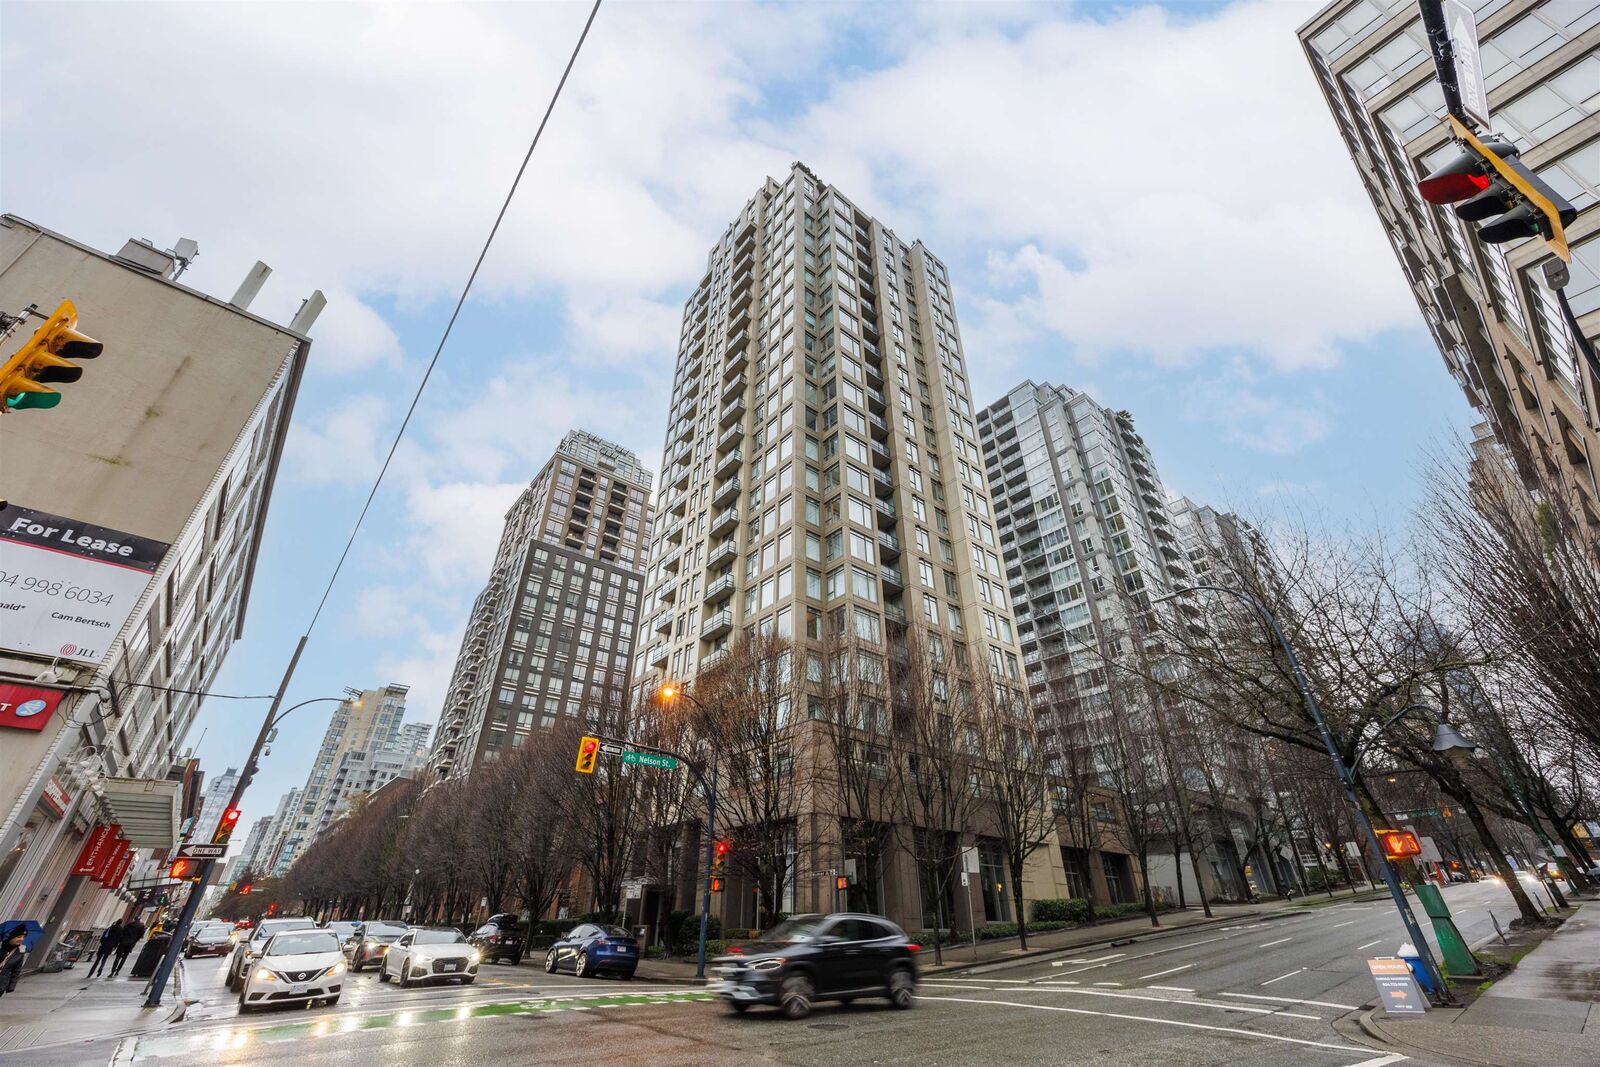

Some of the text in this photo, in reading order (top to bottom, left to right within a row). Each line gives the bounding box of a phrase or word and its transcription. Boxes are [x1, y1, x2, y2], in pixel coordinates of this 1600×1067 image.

[10, 517, 133, 556] For Lease
[20, 577, 63, 596] 998
[64, 586, 114, 607] 6034
[51, 611, 111, 629] Cam Bertsch
[75, 648, 97, 659] JLL
[638, 755, 671, 768] Nelson St.
